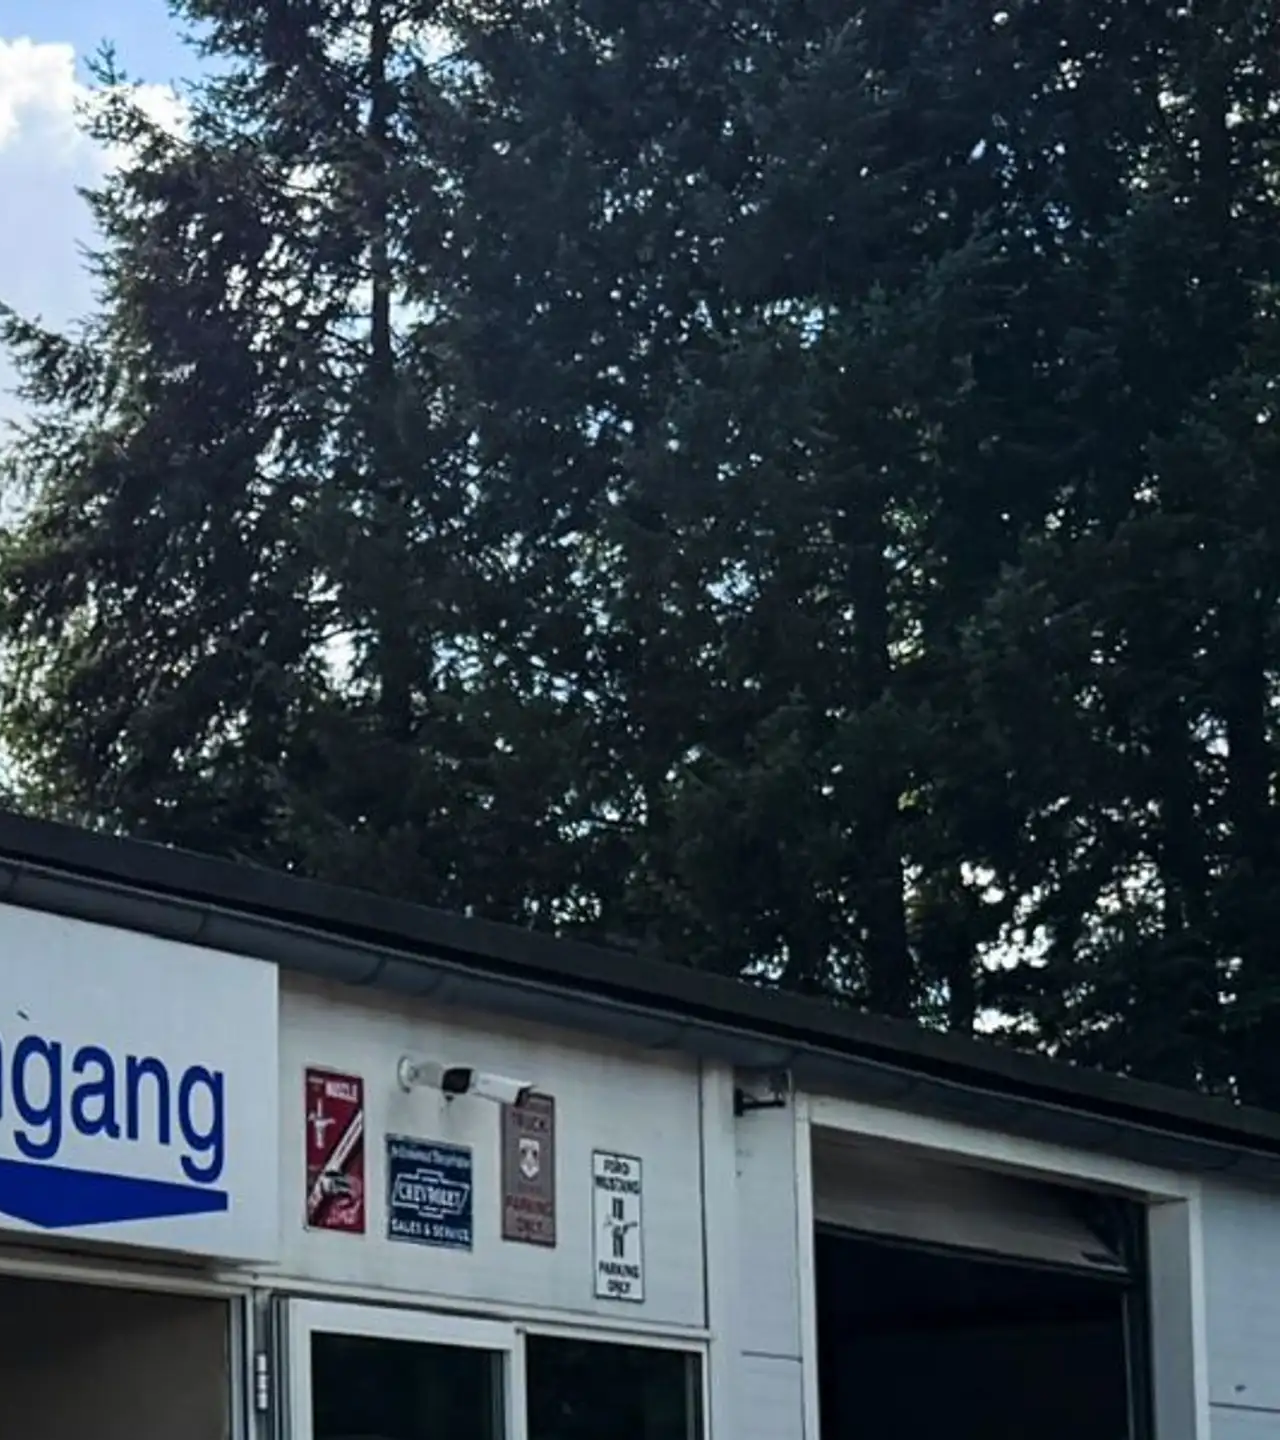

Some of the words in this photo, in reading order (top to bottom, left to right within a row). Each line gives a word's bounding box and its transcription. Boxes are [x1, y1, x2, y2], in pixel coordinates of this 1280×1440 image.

[603, 1158, 631, 1176] FORD
[391, 1218, 422, 1235] SALES
[598, 1260, 640, 1280] PARKING
